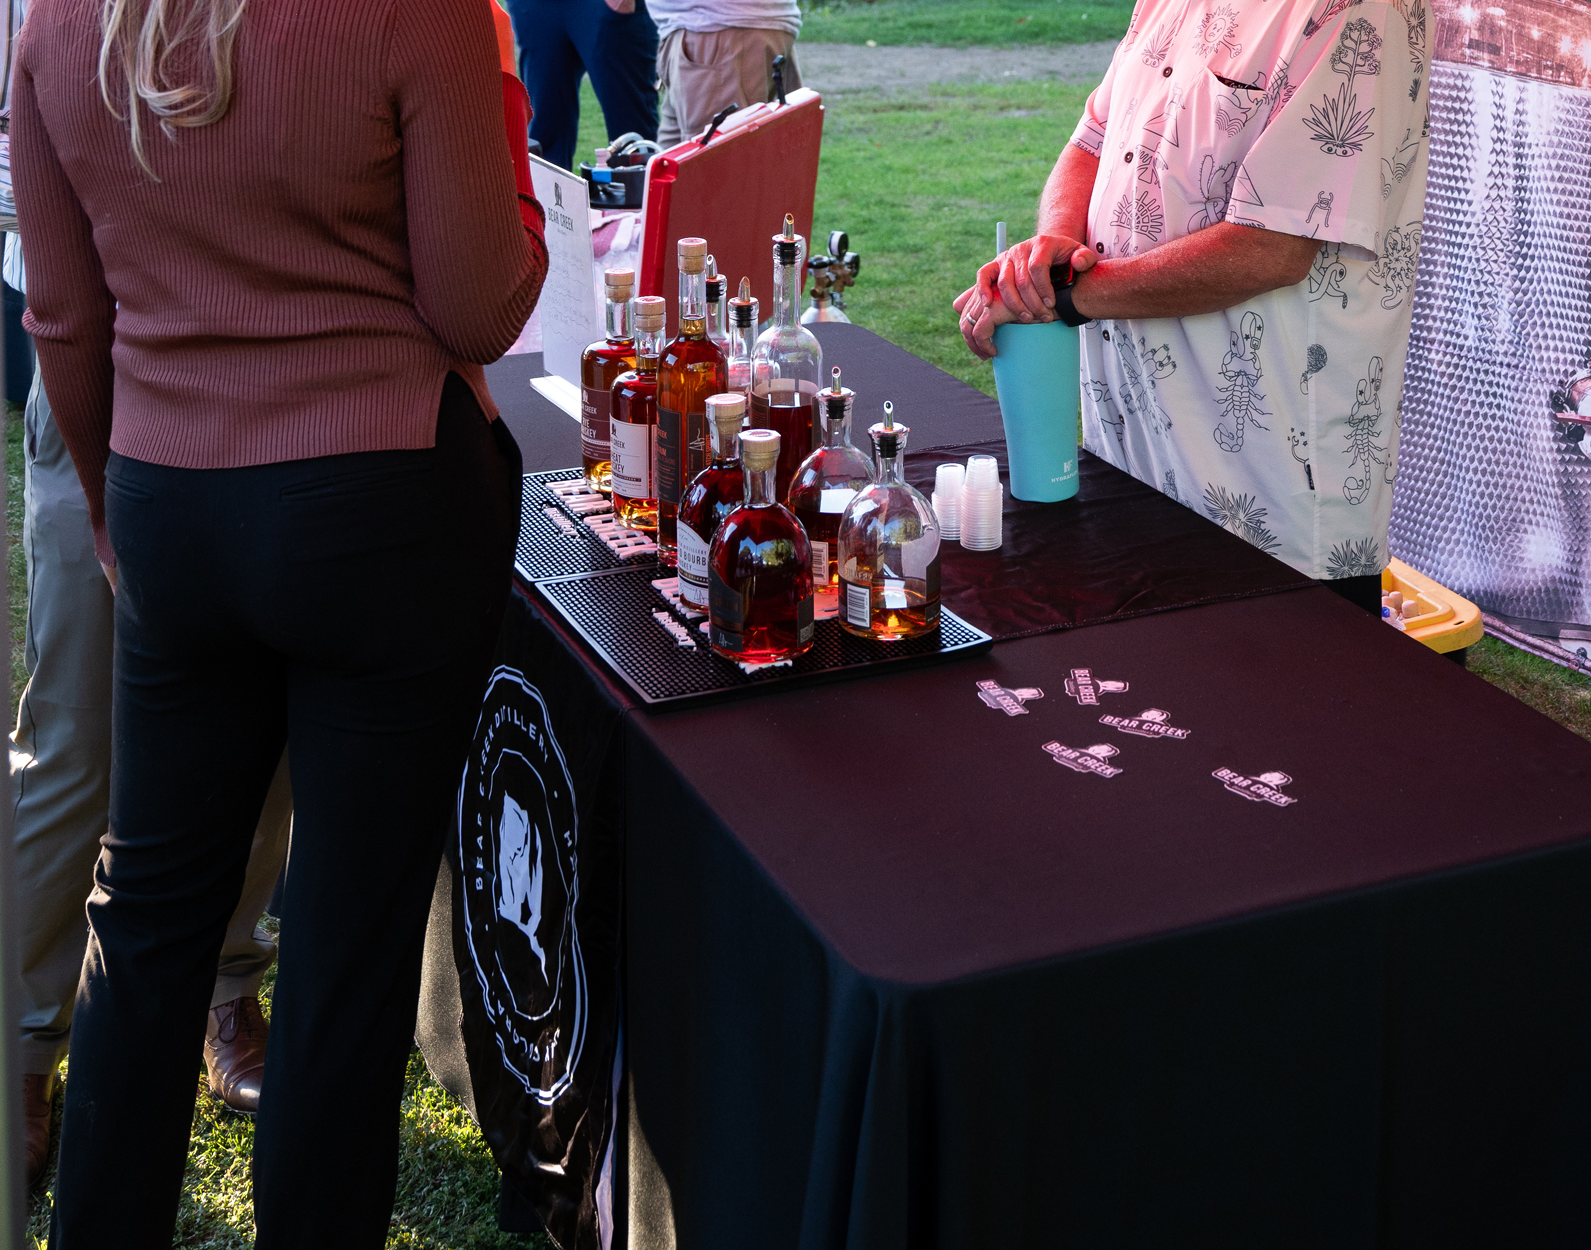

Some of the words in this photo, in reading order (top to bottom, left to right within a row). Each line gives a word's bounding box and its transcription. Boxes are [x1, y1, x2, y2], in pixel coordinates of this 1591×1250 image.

[548, 207, 559, 225] BEAR
[684, 551, 707, 566] BOURB
[1074, 669, 1092, 684] BEAR
[980, 681, 1005, 697] BEAR
[997, 696, 1025, 714] CREEK
[1103, 715, 1139, 728] BEAR
[1142, 722, 1187, 737] CREEK
[479, 723, 495, 797] CEEK
[1046, 742, 1080, 759] BEAR
[1077, 756, 1117, 775] CREEK
[1216, 768, 1252, 787] BEAR
[1250, 784, 1292, 804] CREEK
